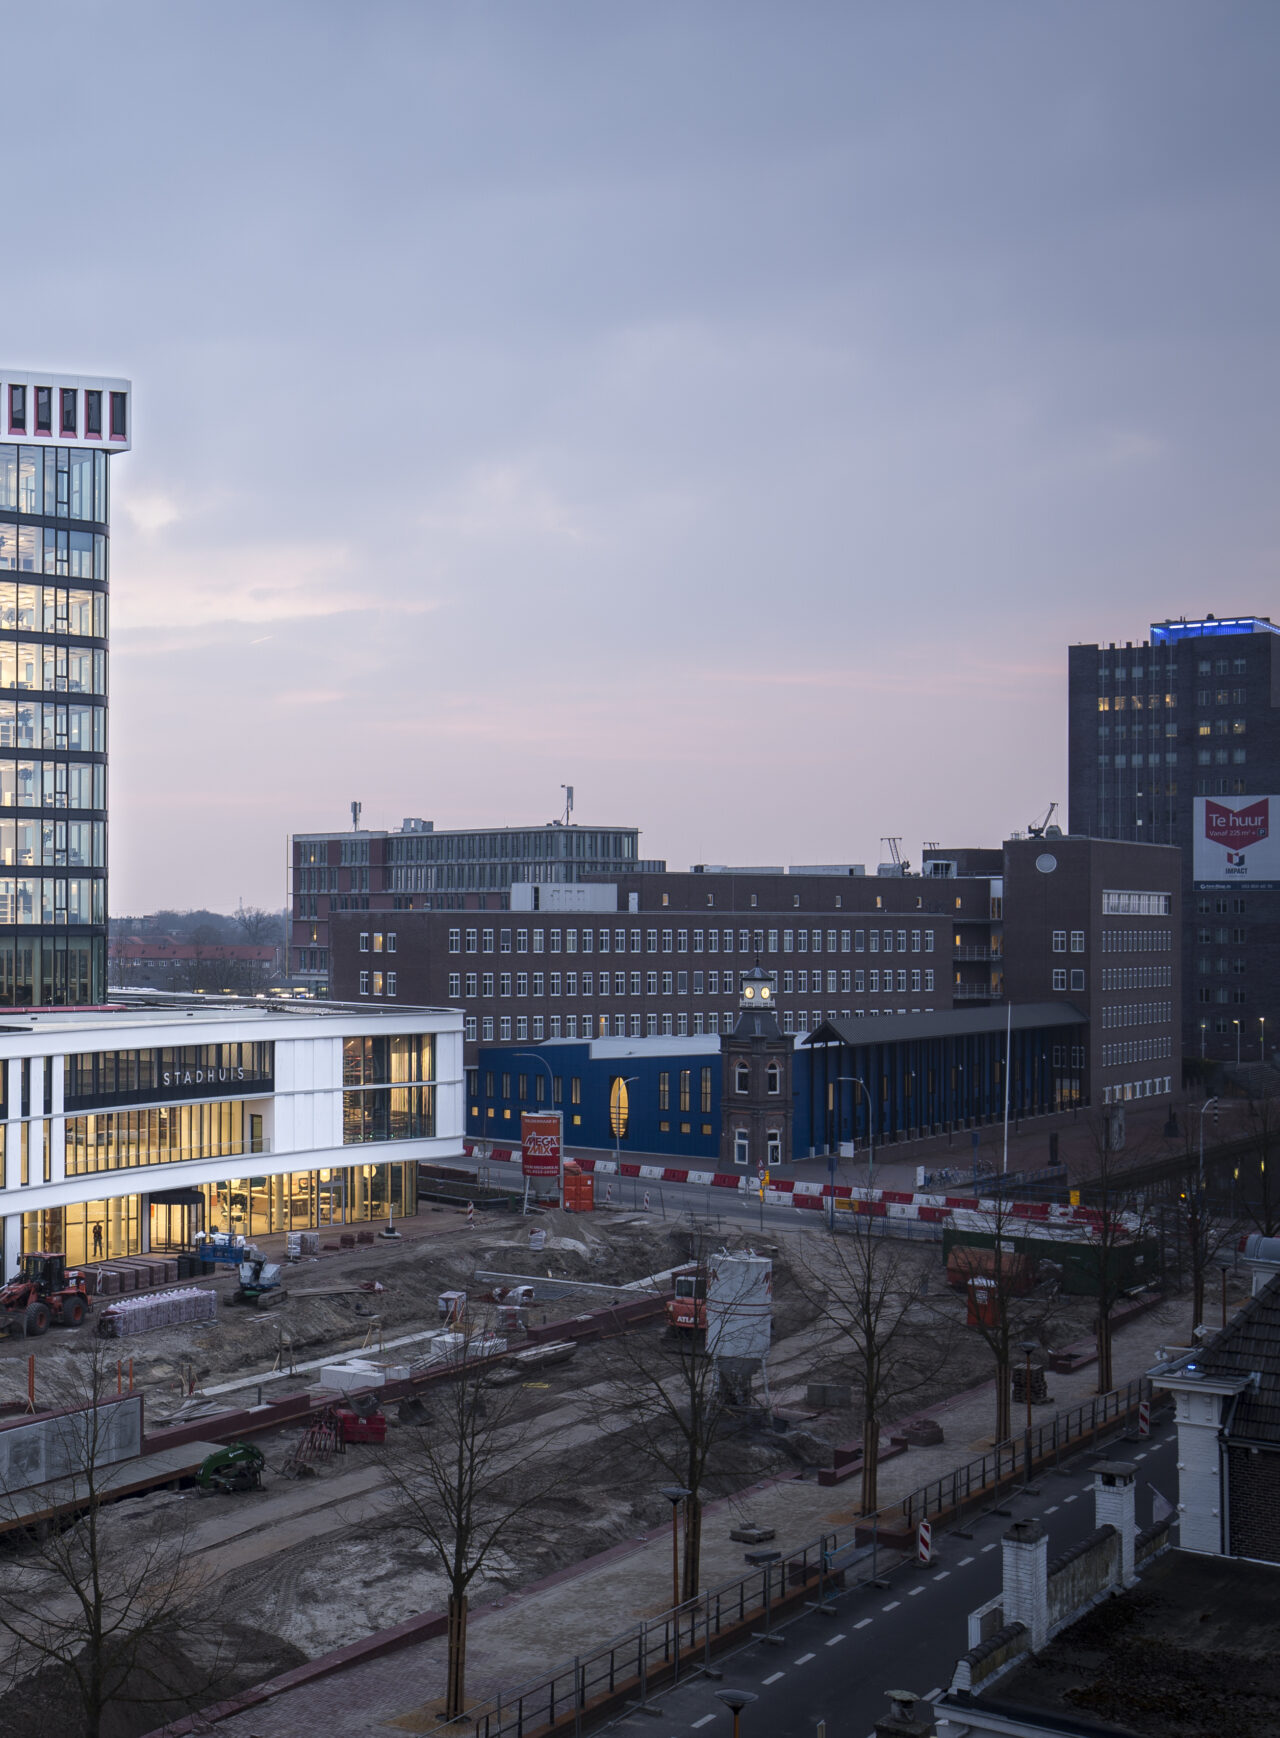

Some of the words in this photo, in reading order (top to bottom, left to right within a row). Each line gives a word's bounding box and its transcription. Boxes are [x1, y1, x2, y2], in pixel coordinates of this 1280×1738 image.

[1209, 814, 1226, 827] Te
[1229, 813, 1264, 827] huur
[163, 1067, 245, 1086] STADHUIS
[525, 1136, 557, 1146] MEGA
[528, 1145, 551, 1155] MIX
